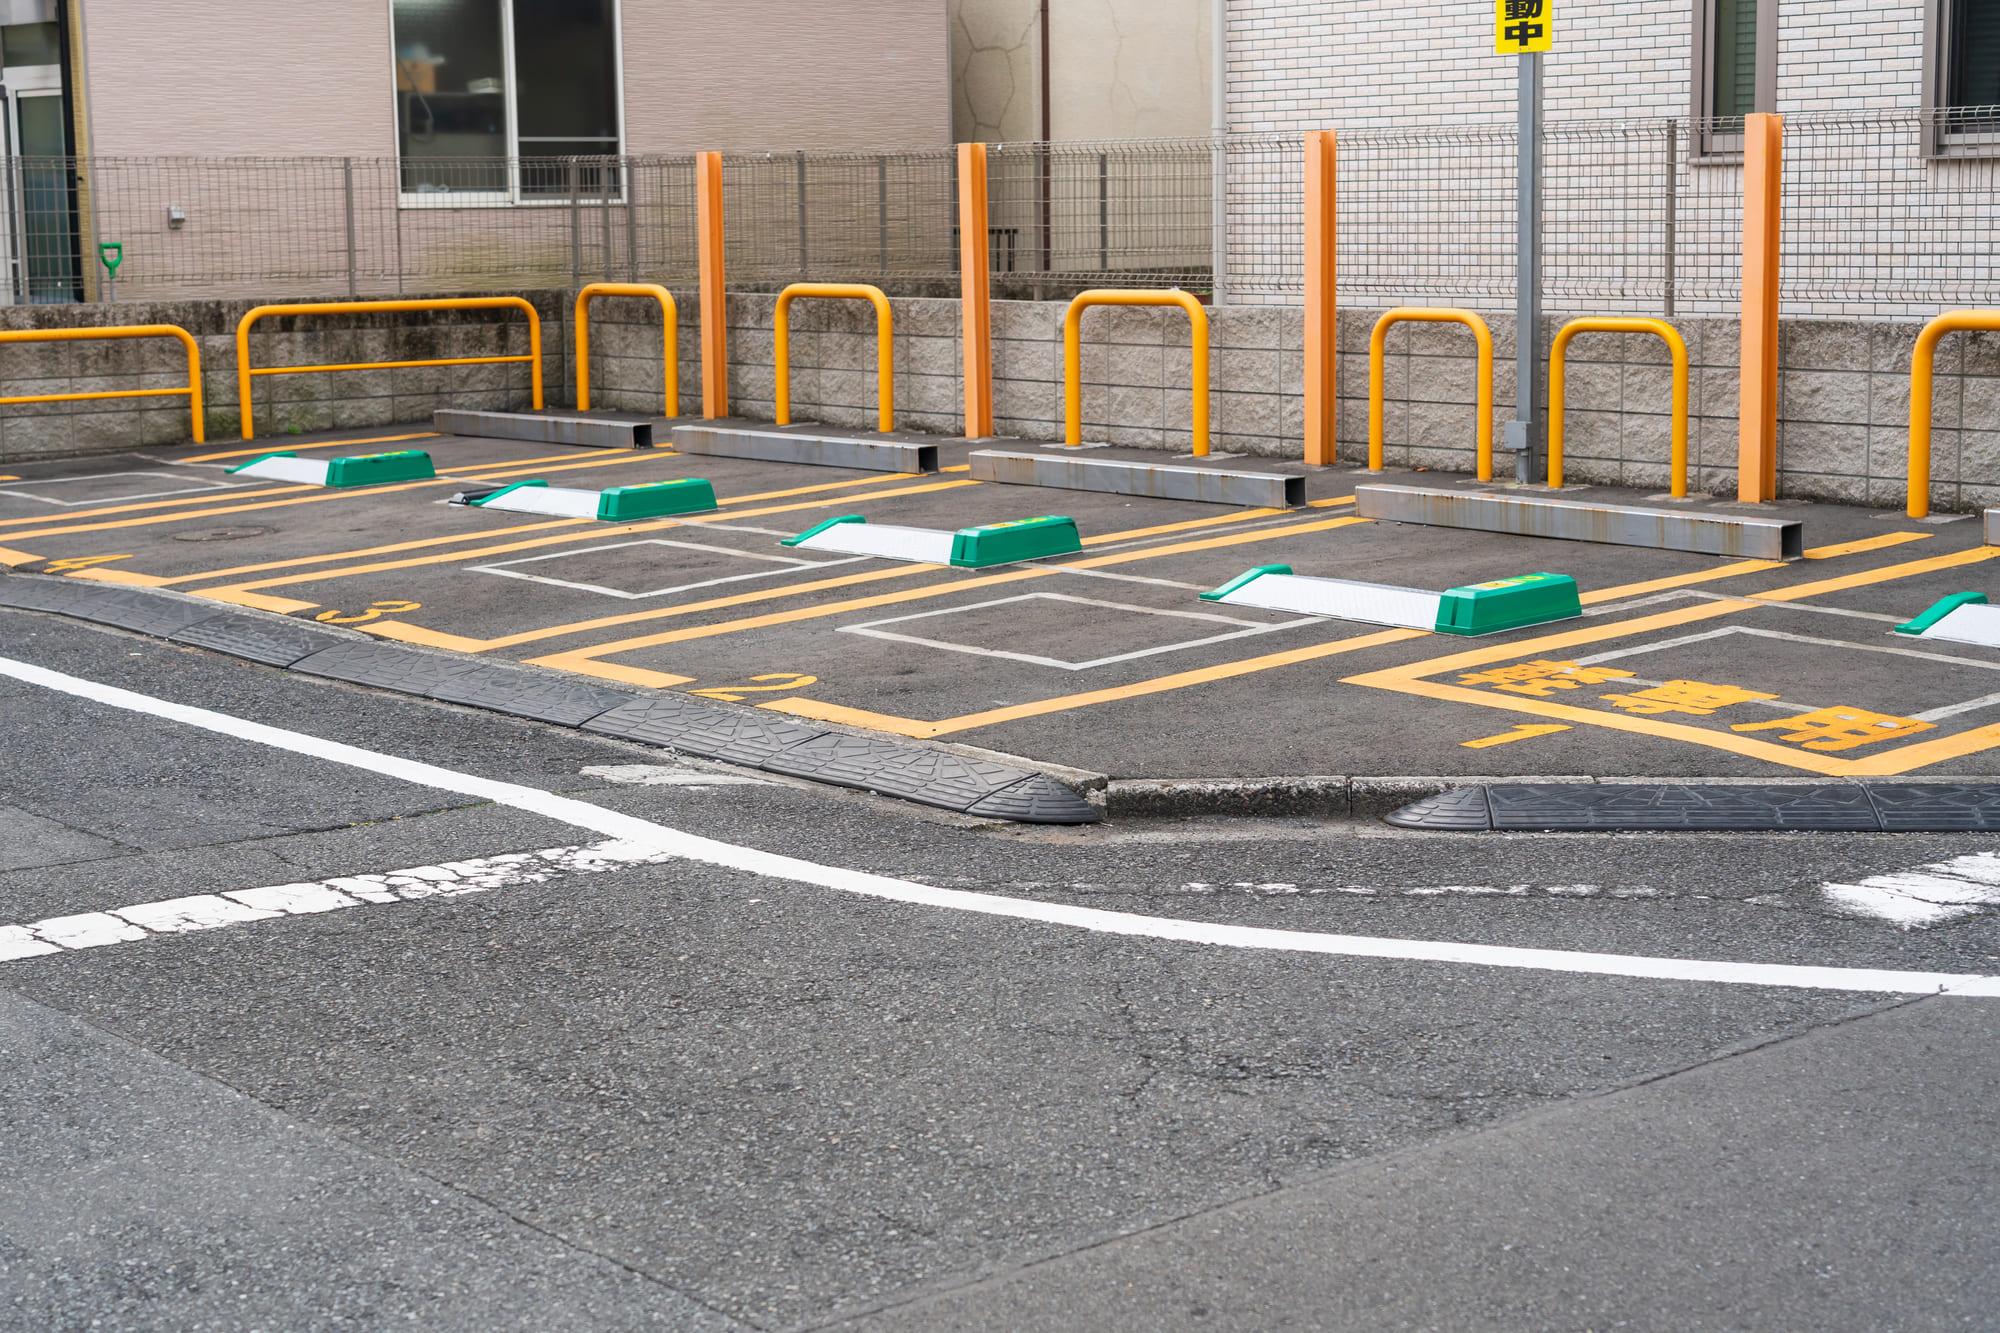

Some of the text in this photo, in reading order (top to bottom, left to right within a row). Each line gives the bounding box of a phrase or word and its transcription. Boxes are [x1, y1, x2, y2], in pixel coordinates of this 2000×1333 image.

[45, 554, 133, 574] 4
[316, 601, 422, 623] 3
[686, 673, 818, 702] 2
[1459, 723, 1575, 749] 1
